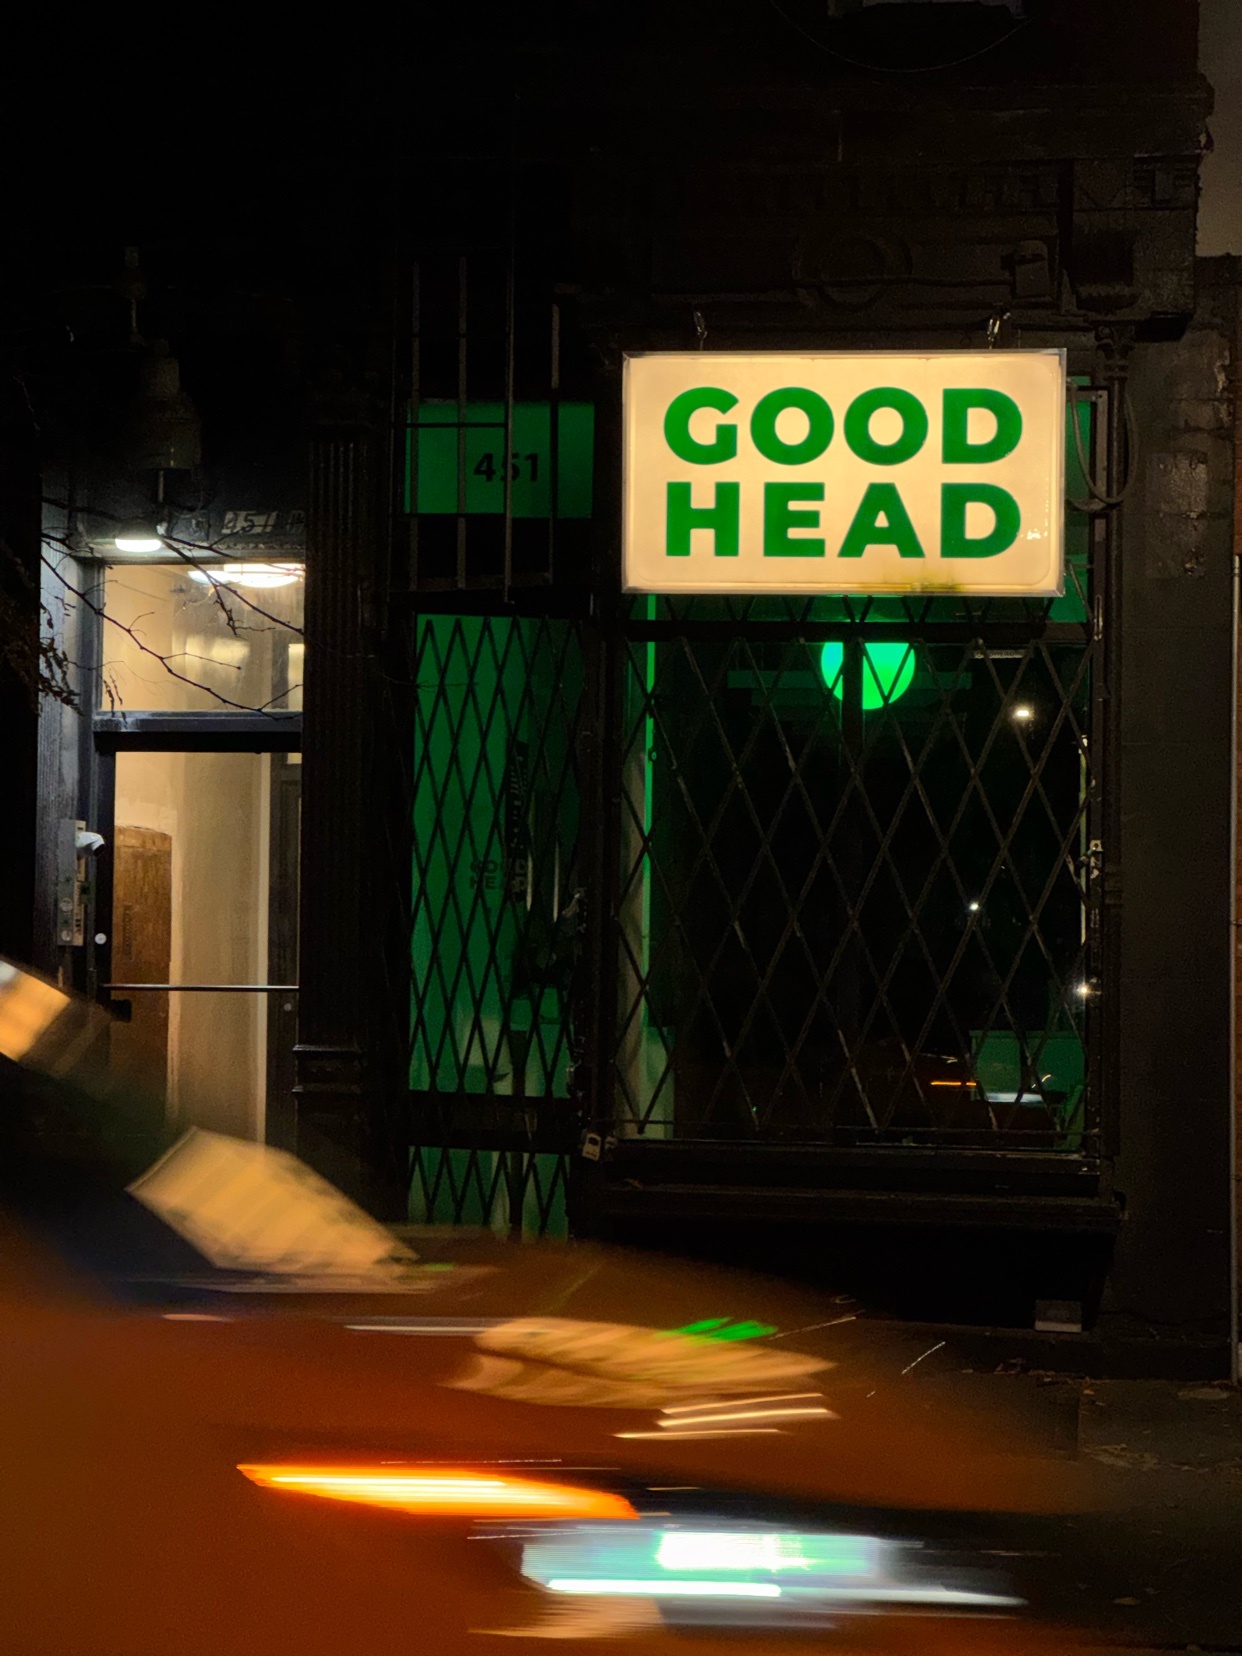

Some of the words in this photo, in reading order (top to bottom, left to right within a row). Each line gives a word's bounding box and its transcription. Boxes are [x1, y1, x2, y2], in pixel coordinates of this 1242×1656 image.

[664, 387, 1022, 465] GOOD
[473, 452, 538, 483] 451
[666, 482, 1020, 558] HEAD
